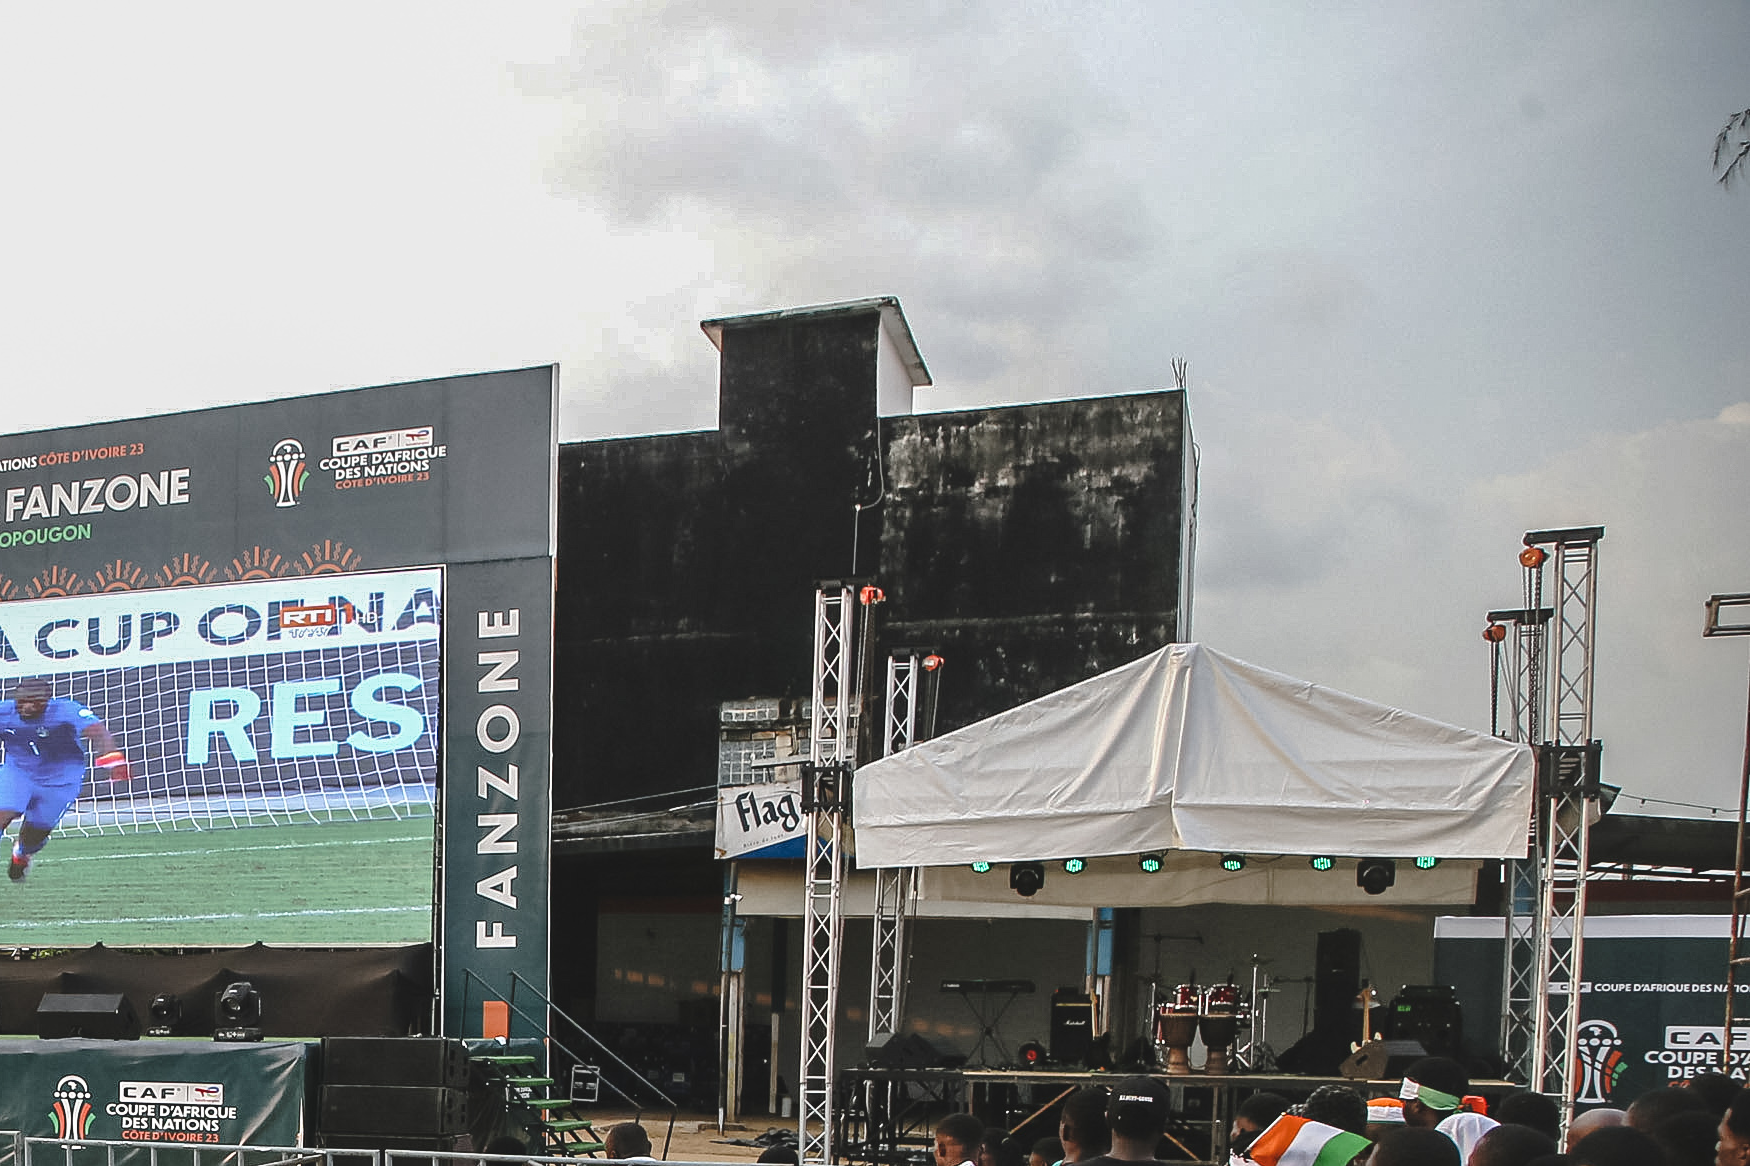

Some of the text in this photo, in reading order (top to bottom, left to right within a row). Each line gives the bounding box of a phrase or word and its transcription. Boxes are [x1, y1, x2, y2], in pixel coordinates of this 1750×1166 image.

[337, 437, 387, 452] CAF
[38, 450, 70, 466] CÔTE
[72, 445, 127, 463] D'IVOIRE
[129, 443, 145, 456] 23
[319, 446, 447, 471] COUPE D'AFRIQUE
[335, 460, 430, 481] DES NATIONS
[416, 472, 430, 481] 23
[5, 467, 190, 523] FANZONE
[283, 608, 332, 625] RTI
[357, 612, 378, 624] HD
[34, 610, 181, 660] CUP
[186, 672, 425, 766] RES
[474, 607, 521, 951] FANZONE
[735, 790, 800, 833] Flag
[1594, 983, 1632, 993] COUPE
[1633, 983, 1691, 993] D'AFRIQUE
[1692, 984, 1713, 993] DES
[1644, 1051, 1718, 1065] COUPE
[123, 1087, 176, 1099] CAF
[106, 1103, 237, 1120] COUPE D'AFRIQUE
[121, 1116, 220, 1132] DES NATIONS
[152, 1131, 202, 1143] D'IVOIRE
[205, 1132, 219, 1143] 23
